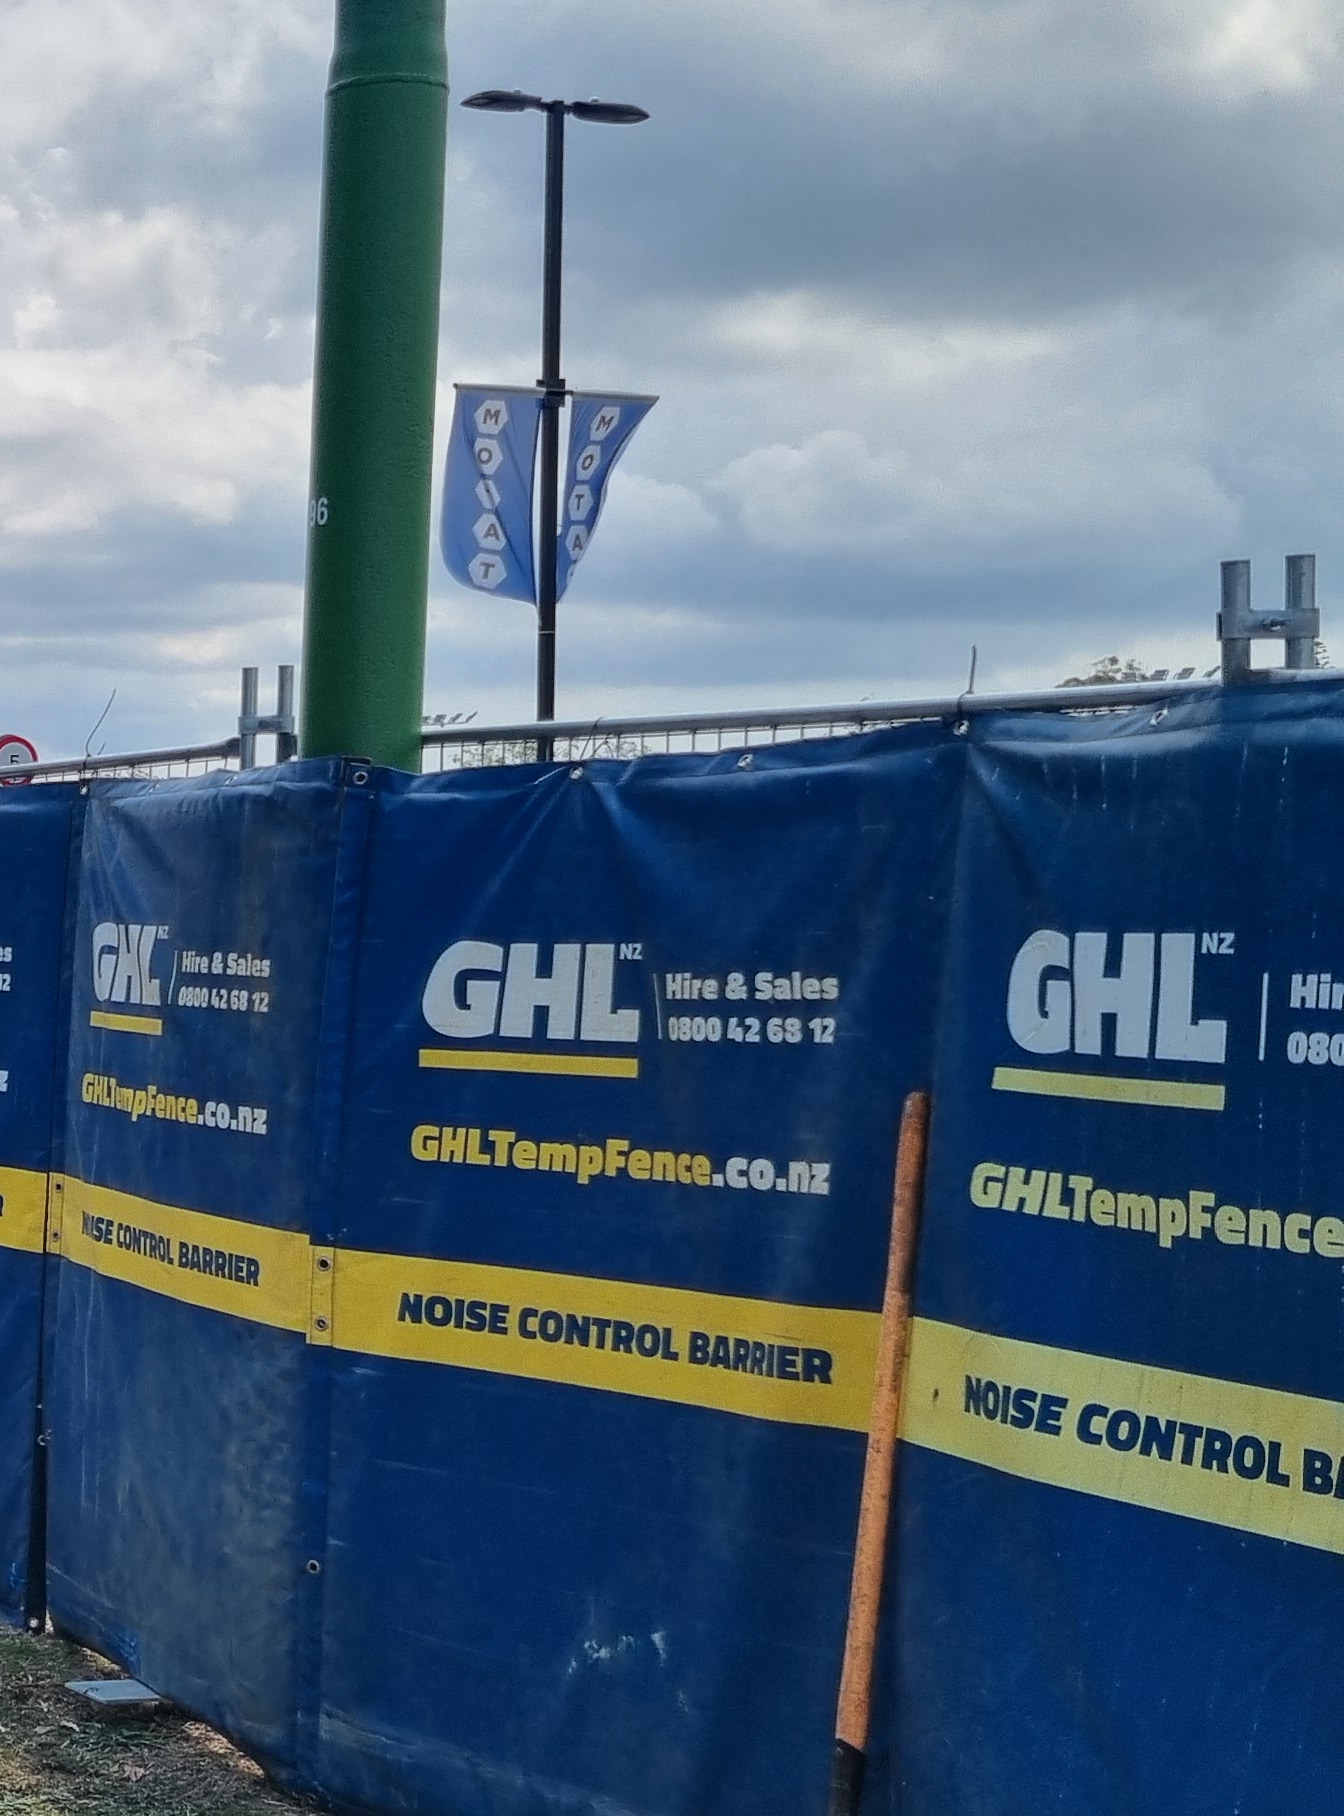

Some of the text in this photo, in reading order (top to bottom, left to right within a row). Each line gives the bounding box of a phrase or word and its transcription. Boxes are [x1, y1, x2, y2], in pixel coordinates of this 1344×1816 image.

[571, 415, 614, 553] MOTA
[91, 922, 169, 1007] GHL NZ
[178, 986, 269, 1013] 0800 42 68 12
[181, 950, 271, 979] Hire & Sales
[422, 940, 642, 1043] GHL NZ
[665, 971, 839, 1002] Hire & Sales
[1007, 929, 1234, 1064] GHL NZ
[668, 1016, 836, 1044] 0800 42 68 12
[411, 1124, 831, 1196] GHLTempFence.co.nz
[116, 1222, 174, 1266] CONTROL
[178, 1241, 261, 1287] BARRIER
[398, 1291, 833, 1384] NOISE CONTROL BARRIER
[963, 1374, 1068, 1437] NOISE
[1076, 1403, 1290, 1489] CONTROL
